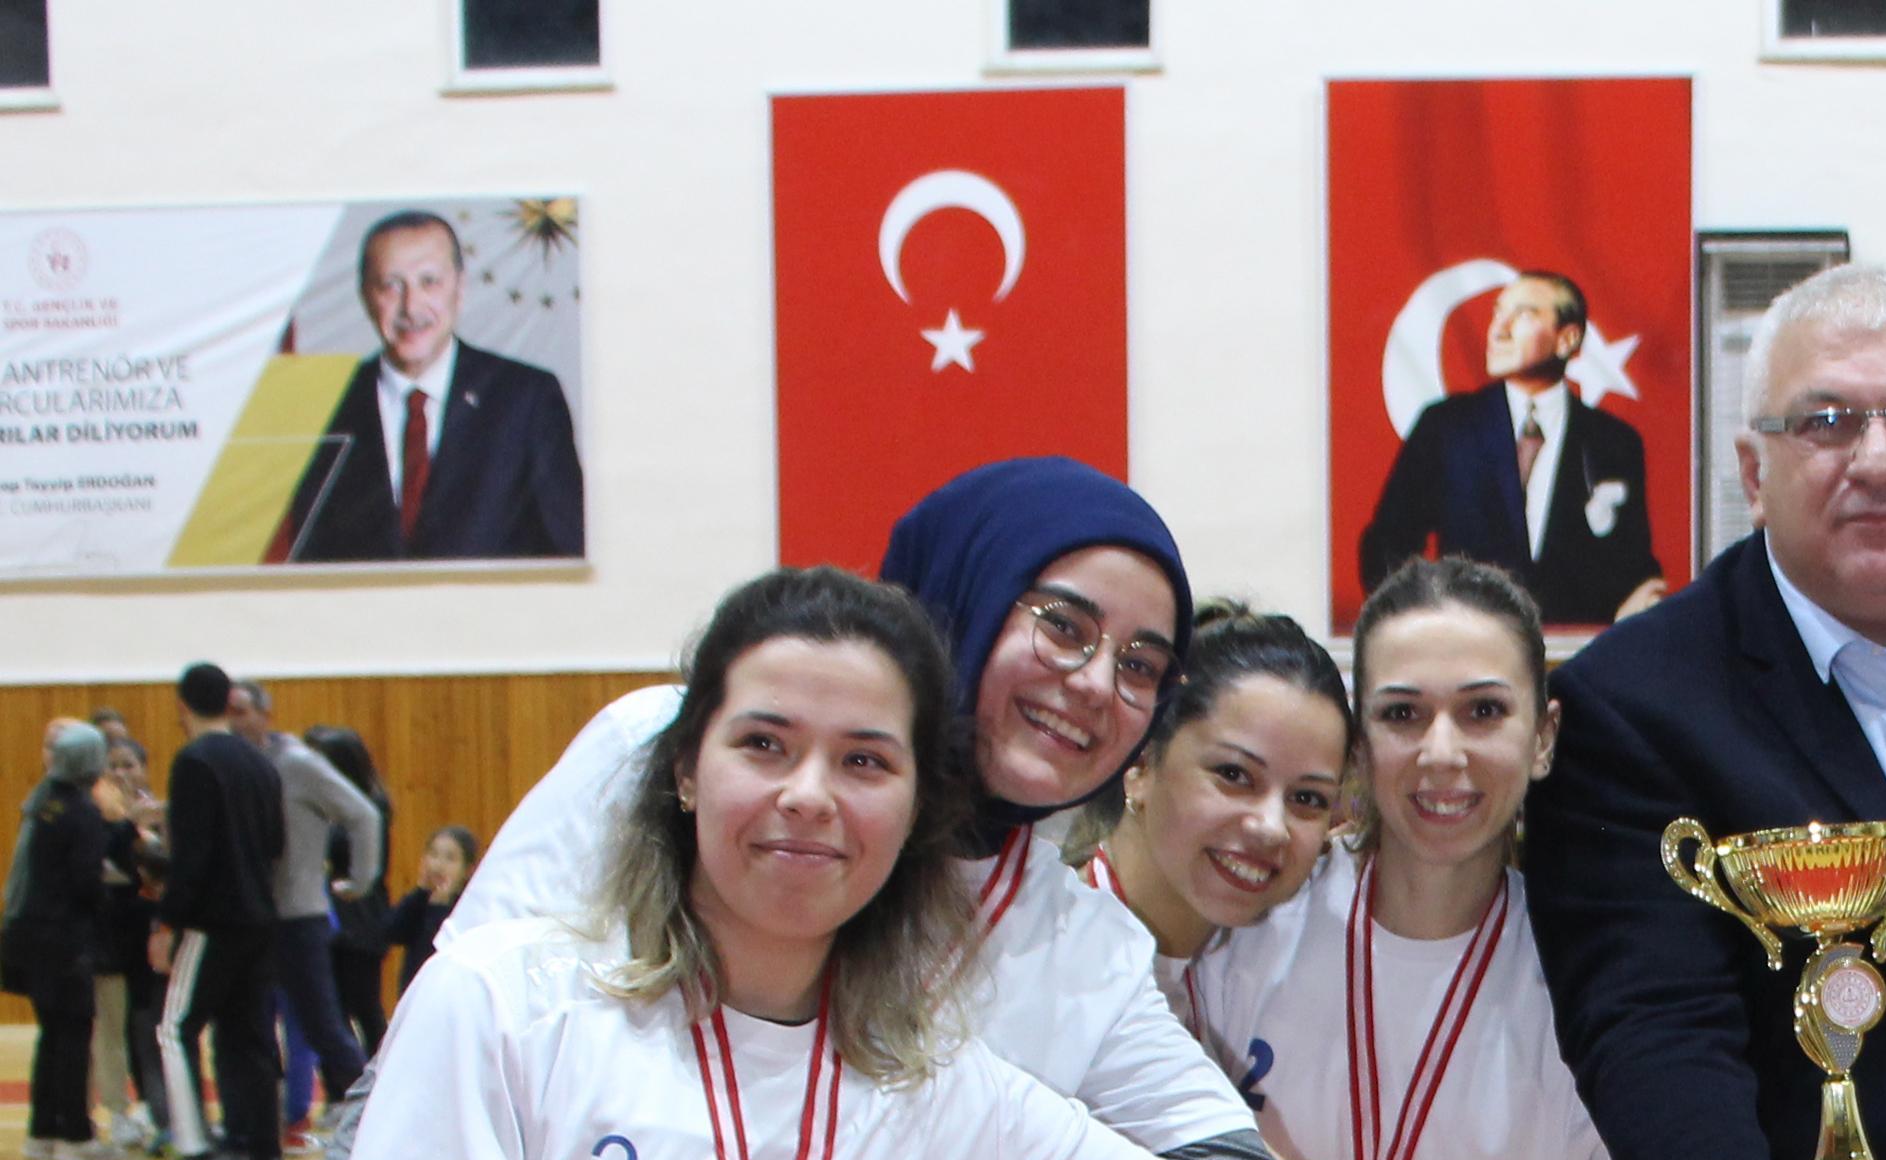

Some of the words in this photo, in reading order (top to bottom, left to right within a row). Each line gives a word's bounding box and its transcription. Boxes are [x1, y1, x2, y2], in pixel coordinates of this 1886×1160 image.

[1, 353, 151, 385] ANTRENÖR
[155, 354, 191, 381] VE
[65, 418, 199, 444] DİLİYORUM
[1238, 1037, 1275, 1112] 2
